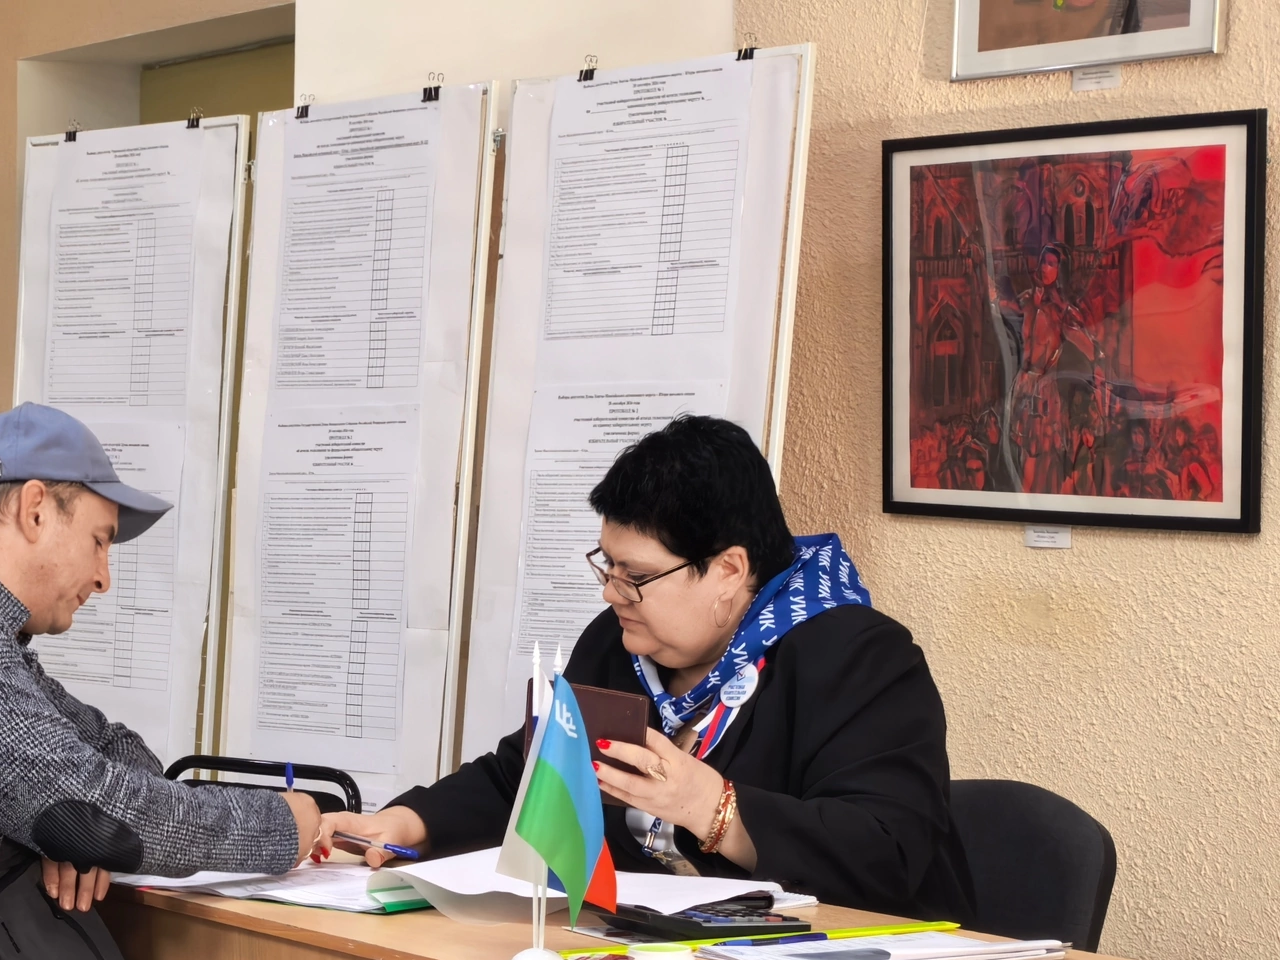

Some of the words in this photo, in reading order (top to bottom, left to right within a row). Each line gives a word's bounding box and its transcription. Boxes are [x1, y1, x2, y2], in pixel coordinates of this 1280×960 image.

[818, 571, 832, 600] УИК
[789, 595, 808, 626] УИК
[731, 643, 749, 673] УИ
